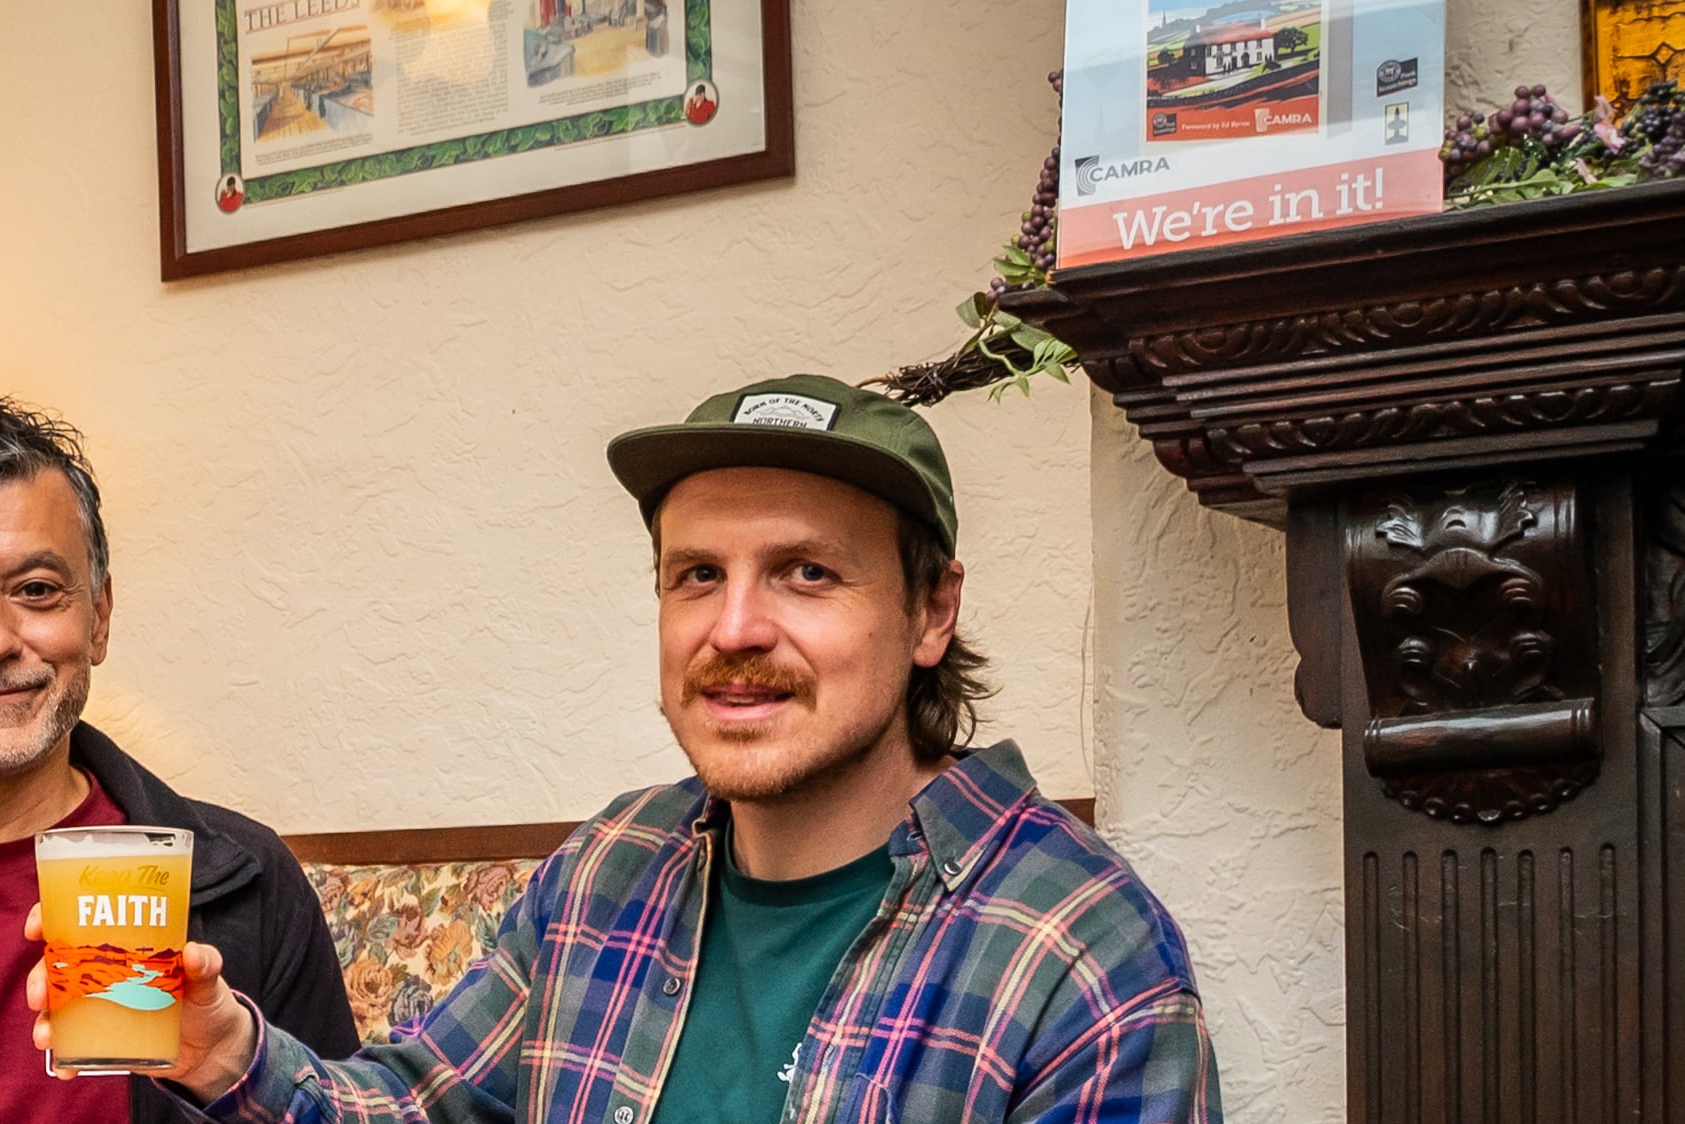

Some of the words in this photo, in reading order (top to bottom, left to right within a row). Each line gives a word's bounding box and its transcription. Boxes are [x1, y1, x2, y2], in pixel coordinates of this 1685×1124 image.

[243, 4, 287, 34] THE
[1181, 122, 1212, 131] Foreword
[1263, 112, 1313, 125] CAMRA
[1089, 156, 1170, 182] CAMRA
[1113, 199, 1255, 250] We're
[1269, 183, 1324, 226] in
[1335, 166, 1385, 216] it!
[784, 397, 801, 406] THE
[752, 416, 808, 428] NORTHERN
[137, 864, 170, 887] The
[77, 894, 168, 927] FAITH
